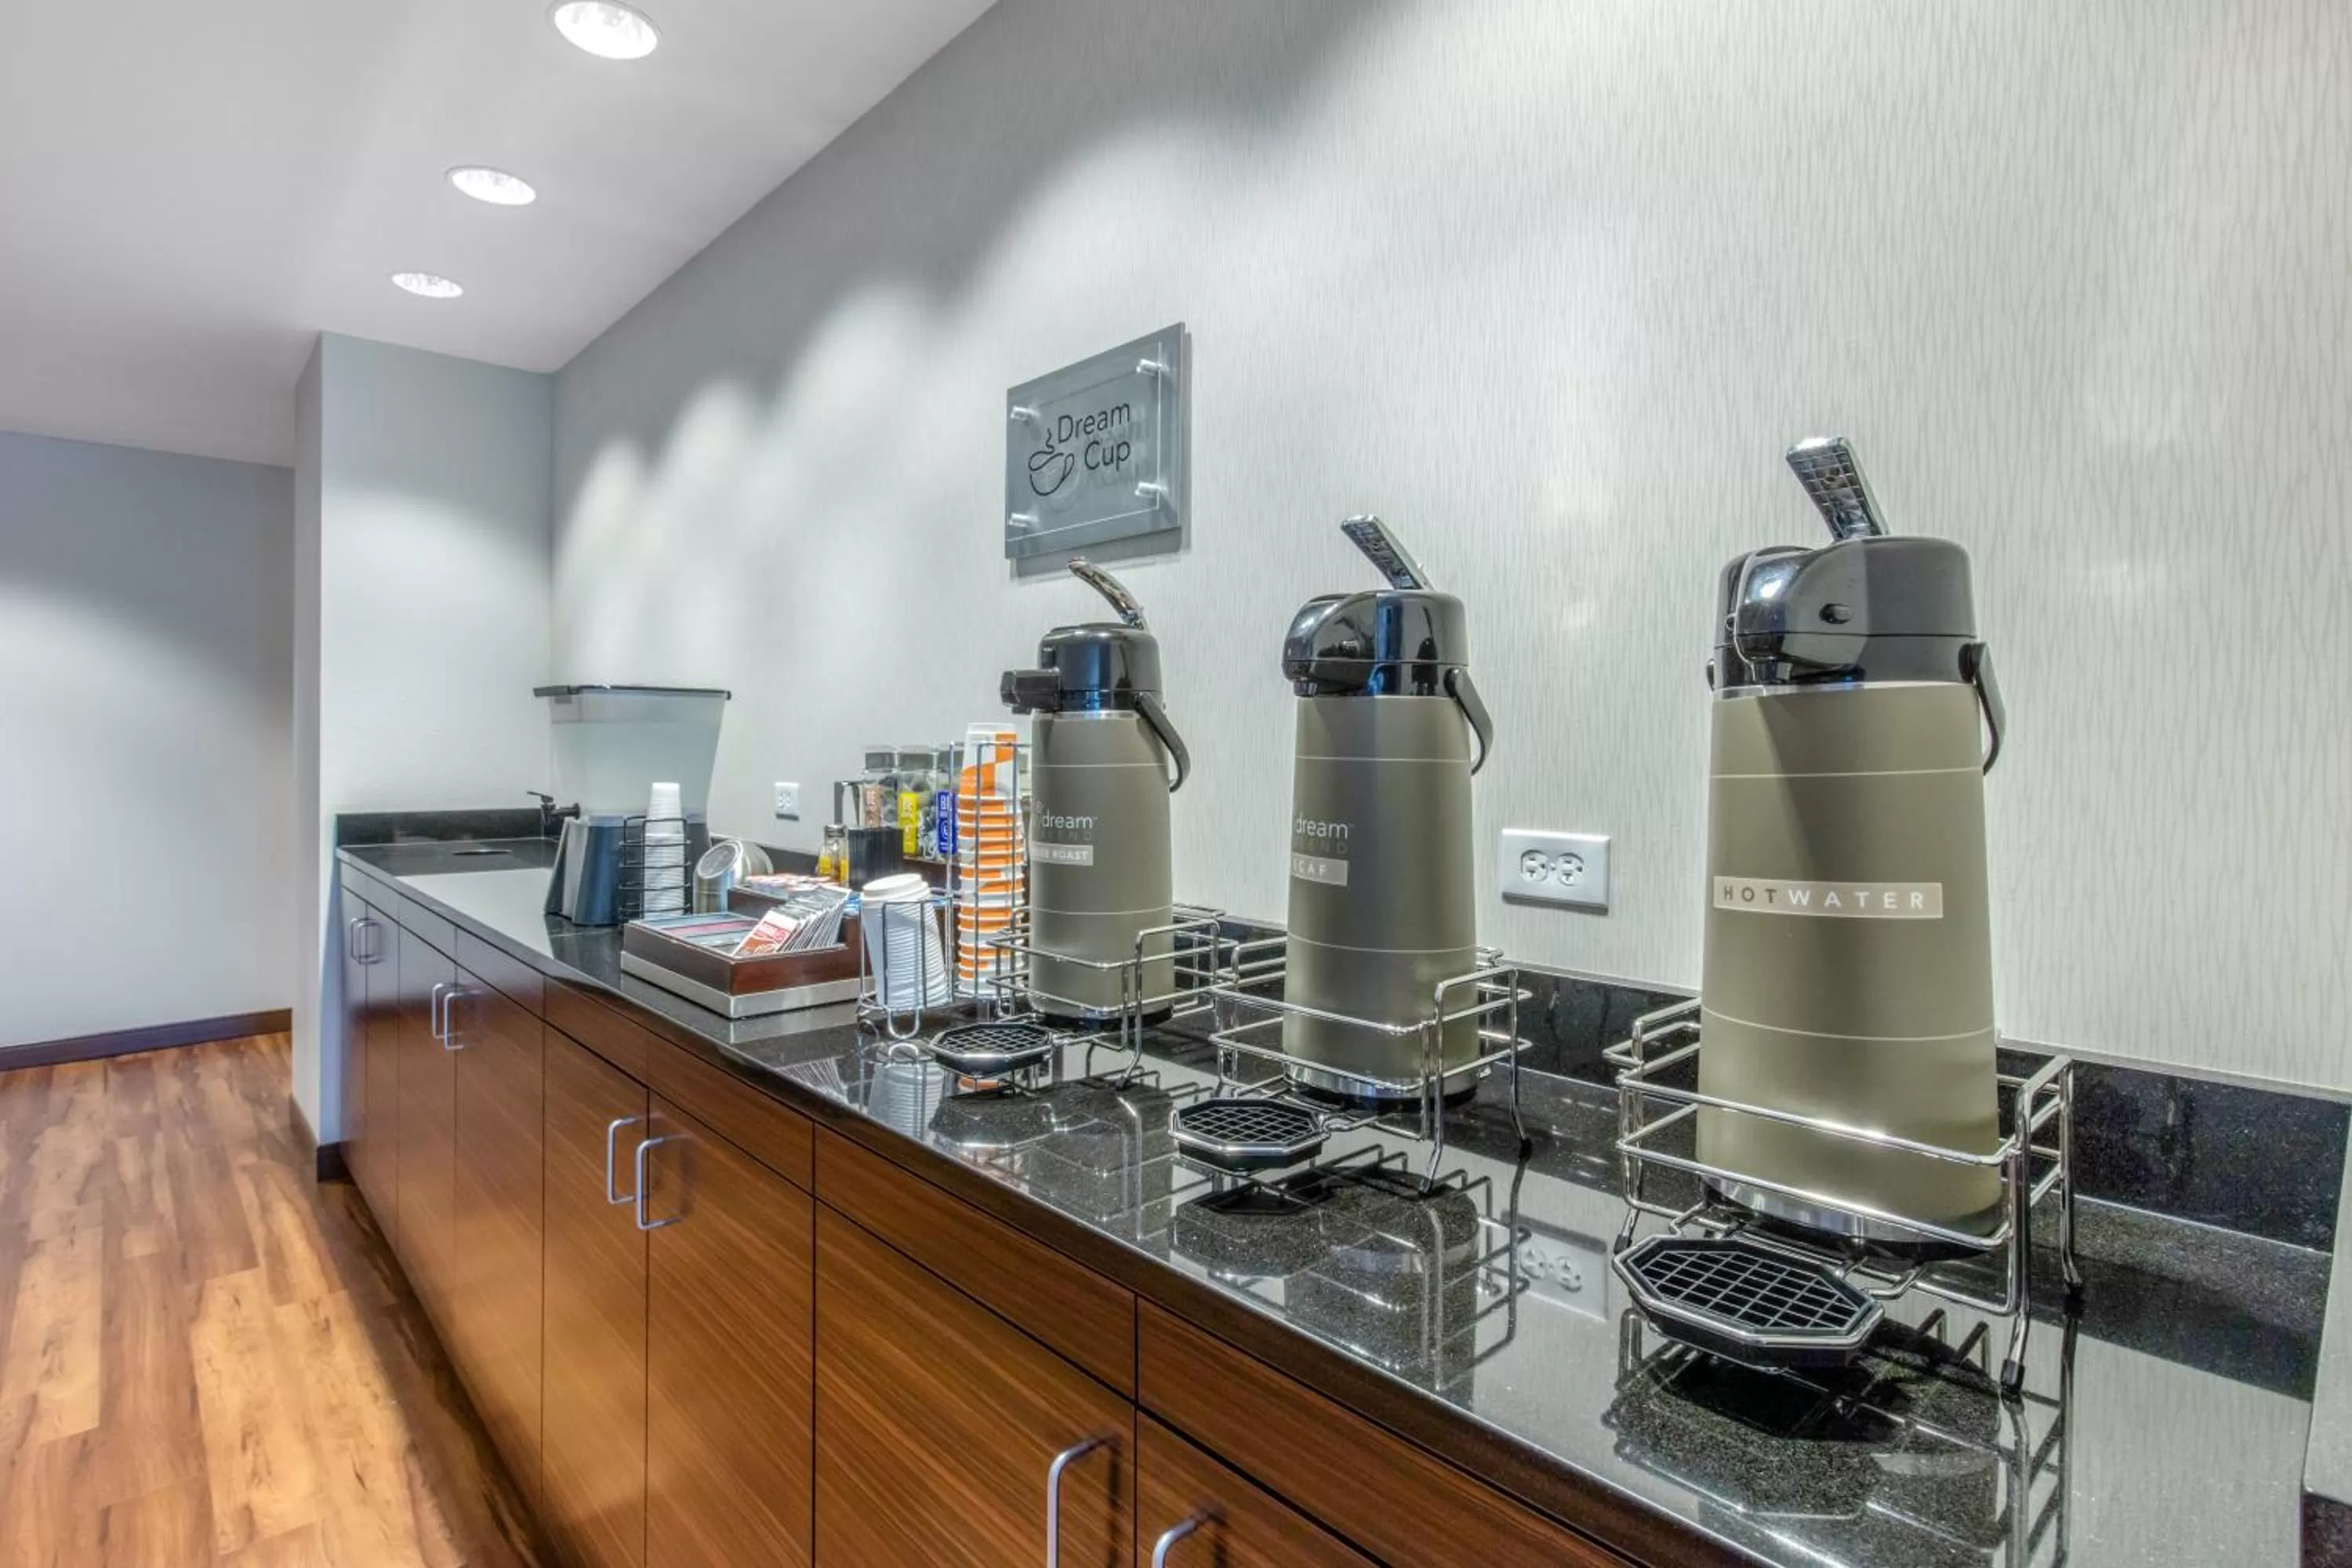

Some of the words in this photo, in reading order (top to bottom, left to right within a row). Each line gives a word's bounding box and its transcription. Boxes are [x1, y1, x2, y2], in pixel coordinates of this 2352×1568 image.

[1058, 402, 1130, 444] Dream
[1084, 440, 1131, 472] Cup
[1041, 808, 1093, 829] dream
[1788, 888, 1924, 910] WATER
